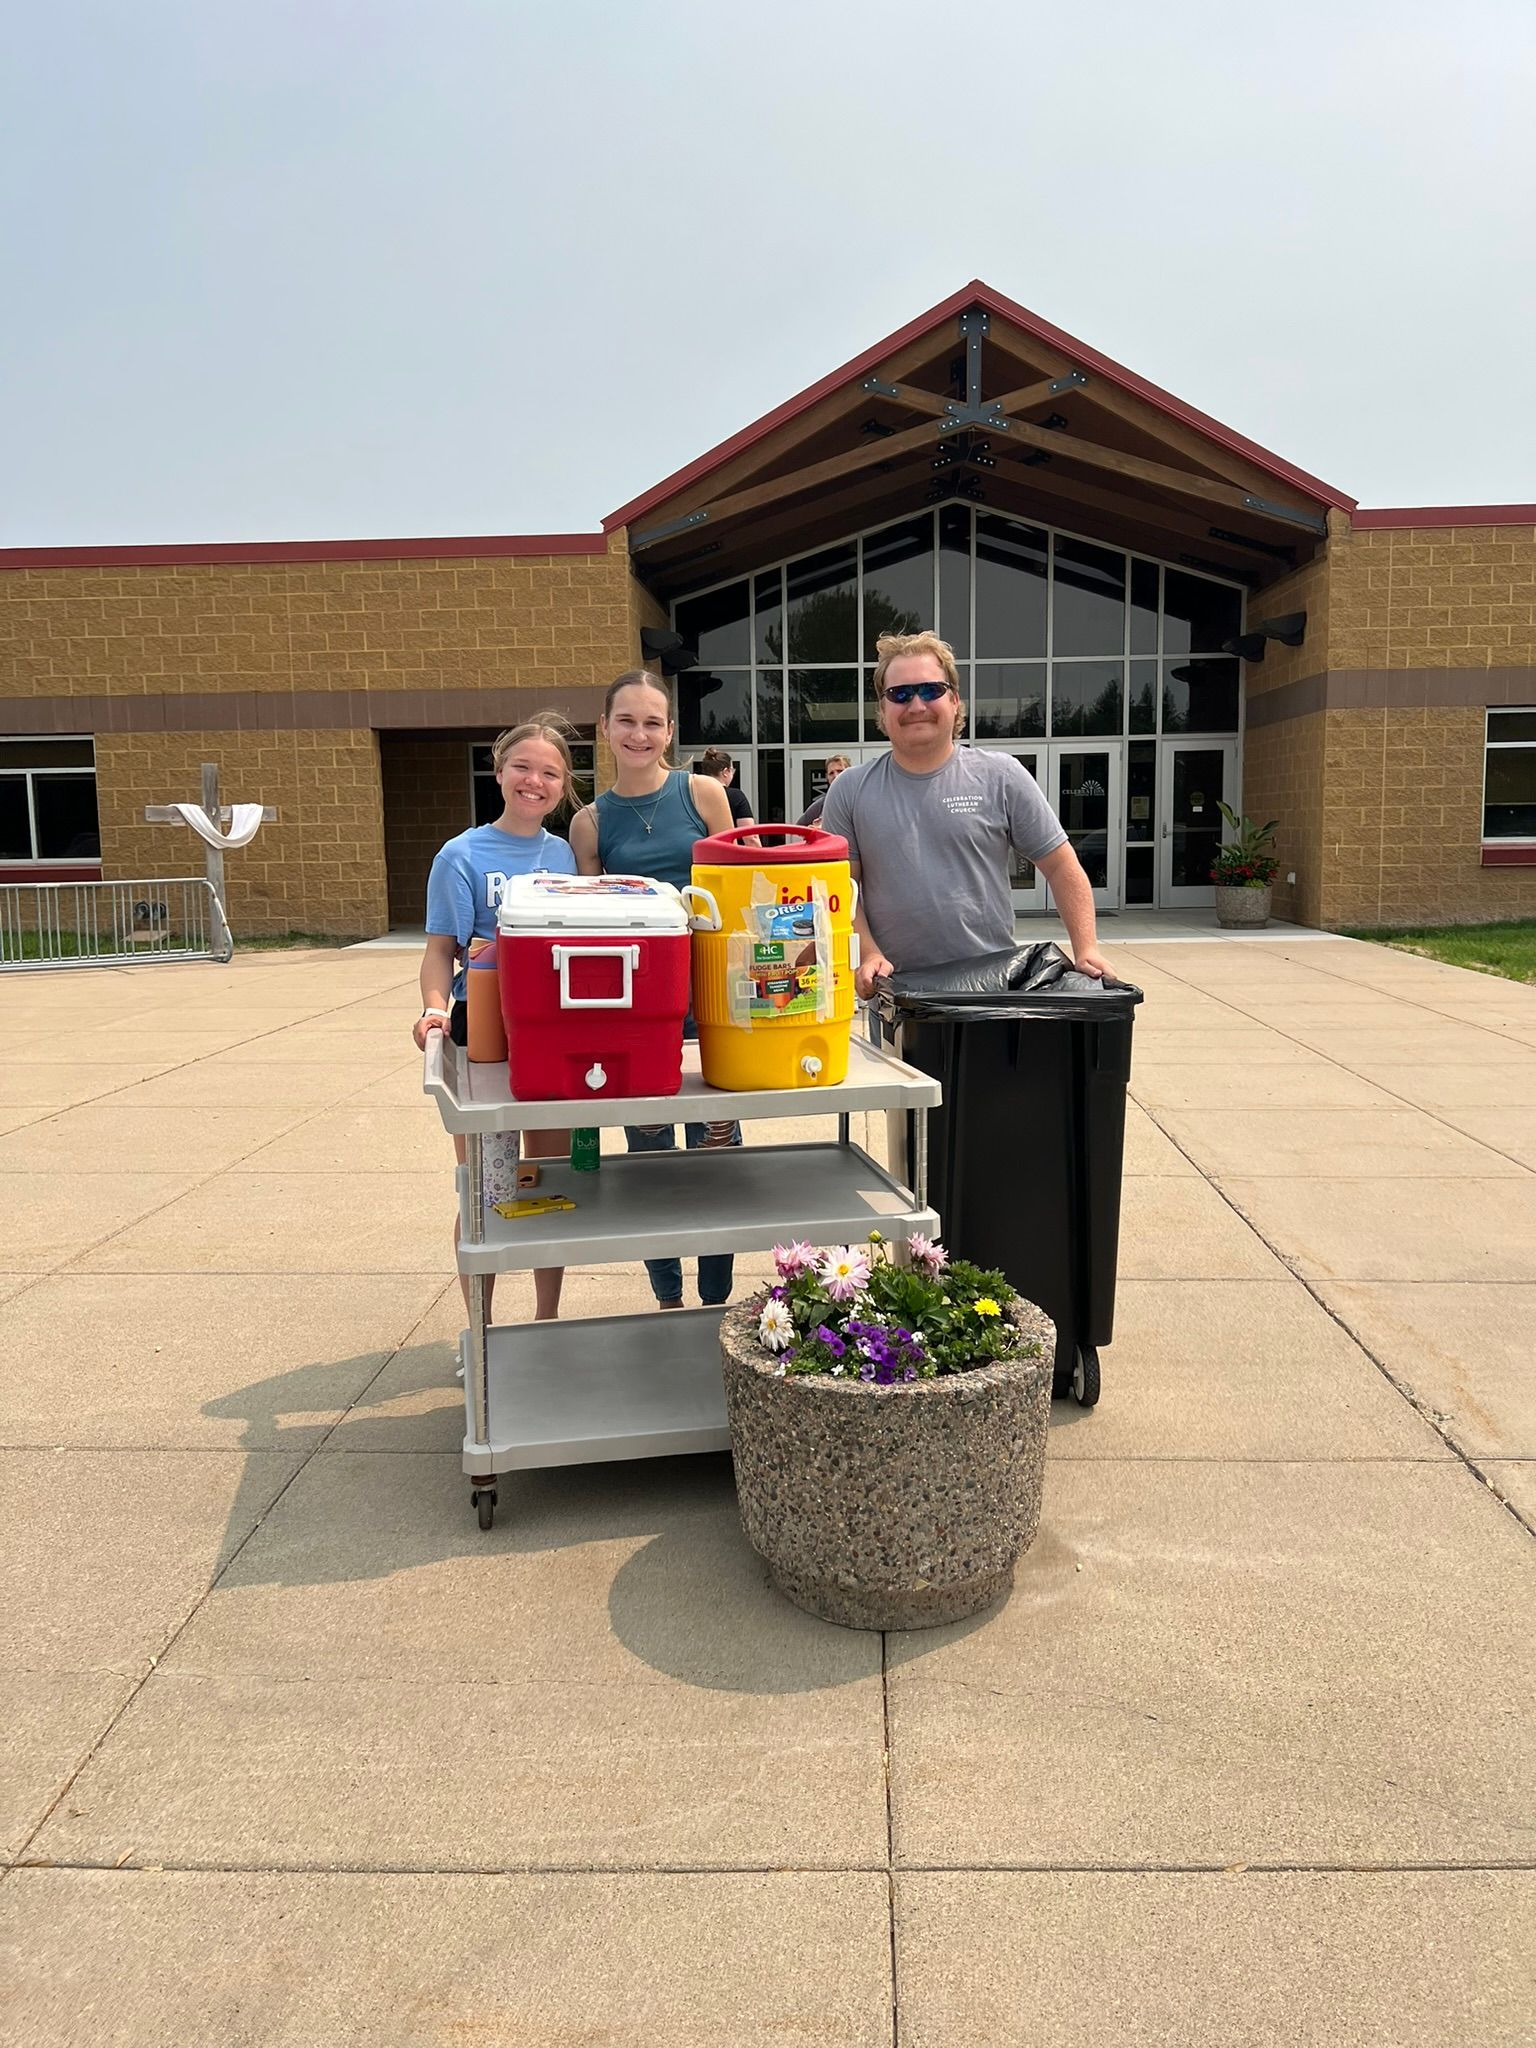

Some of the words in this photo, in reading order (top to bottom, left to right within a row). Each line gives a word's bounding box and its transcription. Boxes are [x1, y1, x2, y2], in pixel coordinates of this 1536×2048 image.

[942, 795, 983, 803] CELEBRATION
[947, 801, 979, 809] LUTHERAN
[765, 904, 805, 919] OREO
